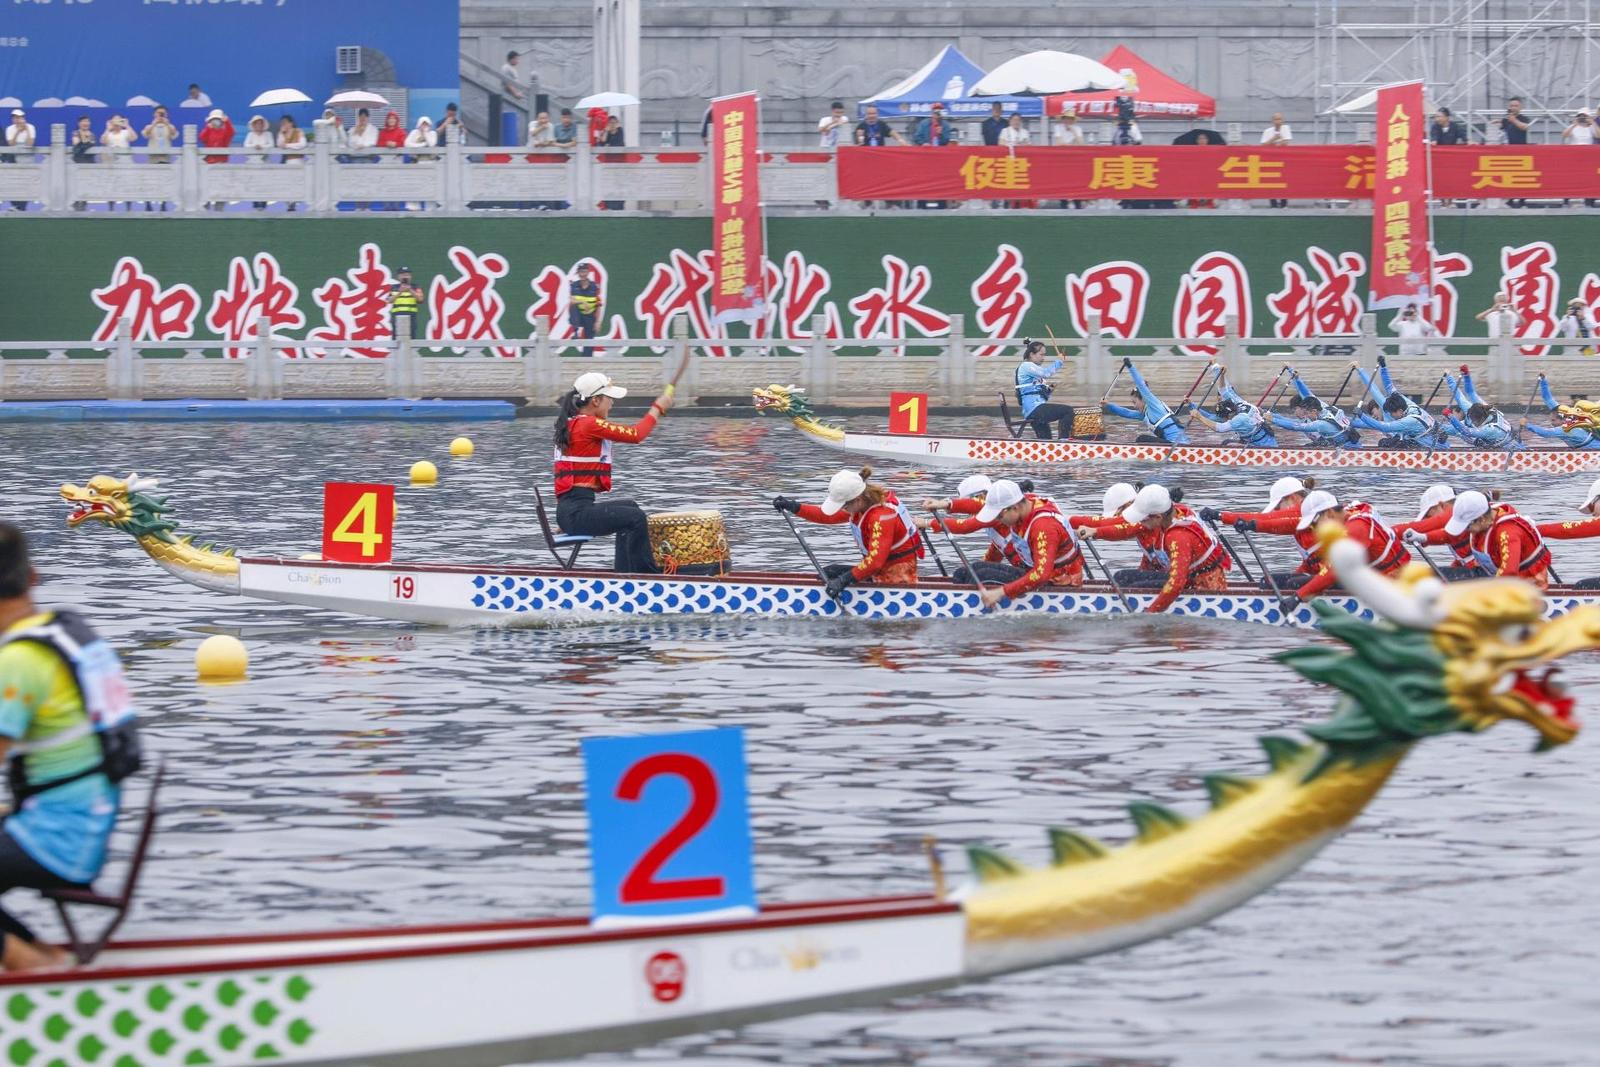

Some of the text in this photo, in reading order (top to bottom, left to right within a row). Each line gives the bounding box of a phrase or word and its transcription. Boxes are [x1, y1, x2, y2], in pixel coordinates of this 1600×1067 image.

[898, 397, 919, 432] 1
[928, 441, 940, 453] 17
[332, 492, 383, 557] 4
[393, 576, 414, 599] 19
[613, 752, 726, 904] 2
